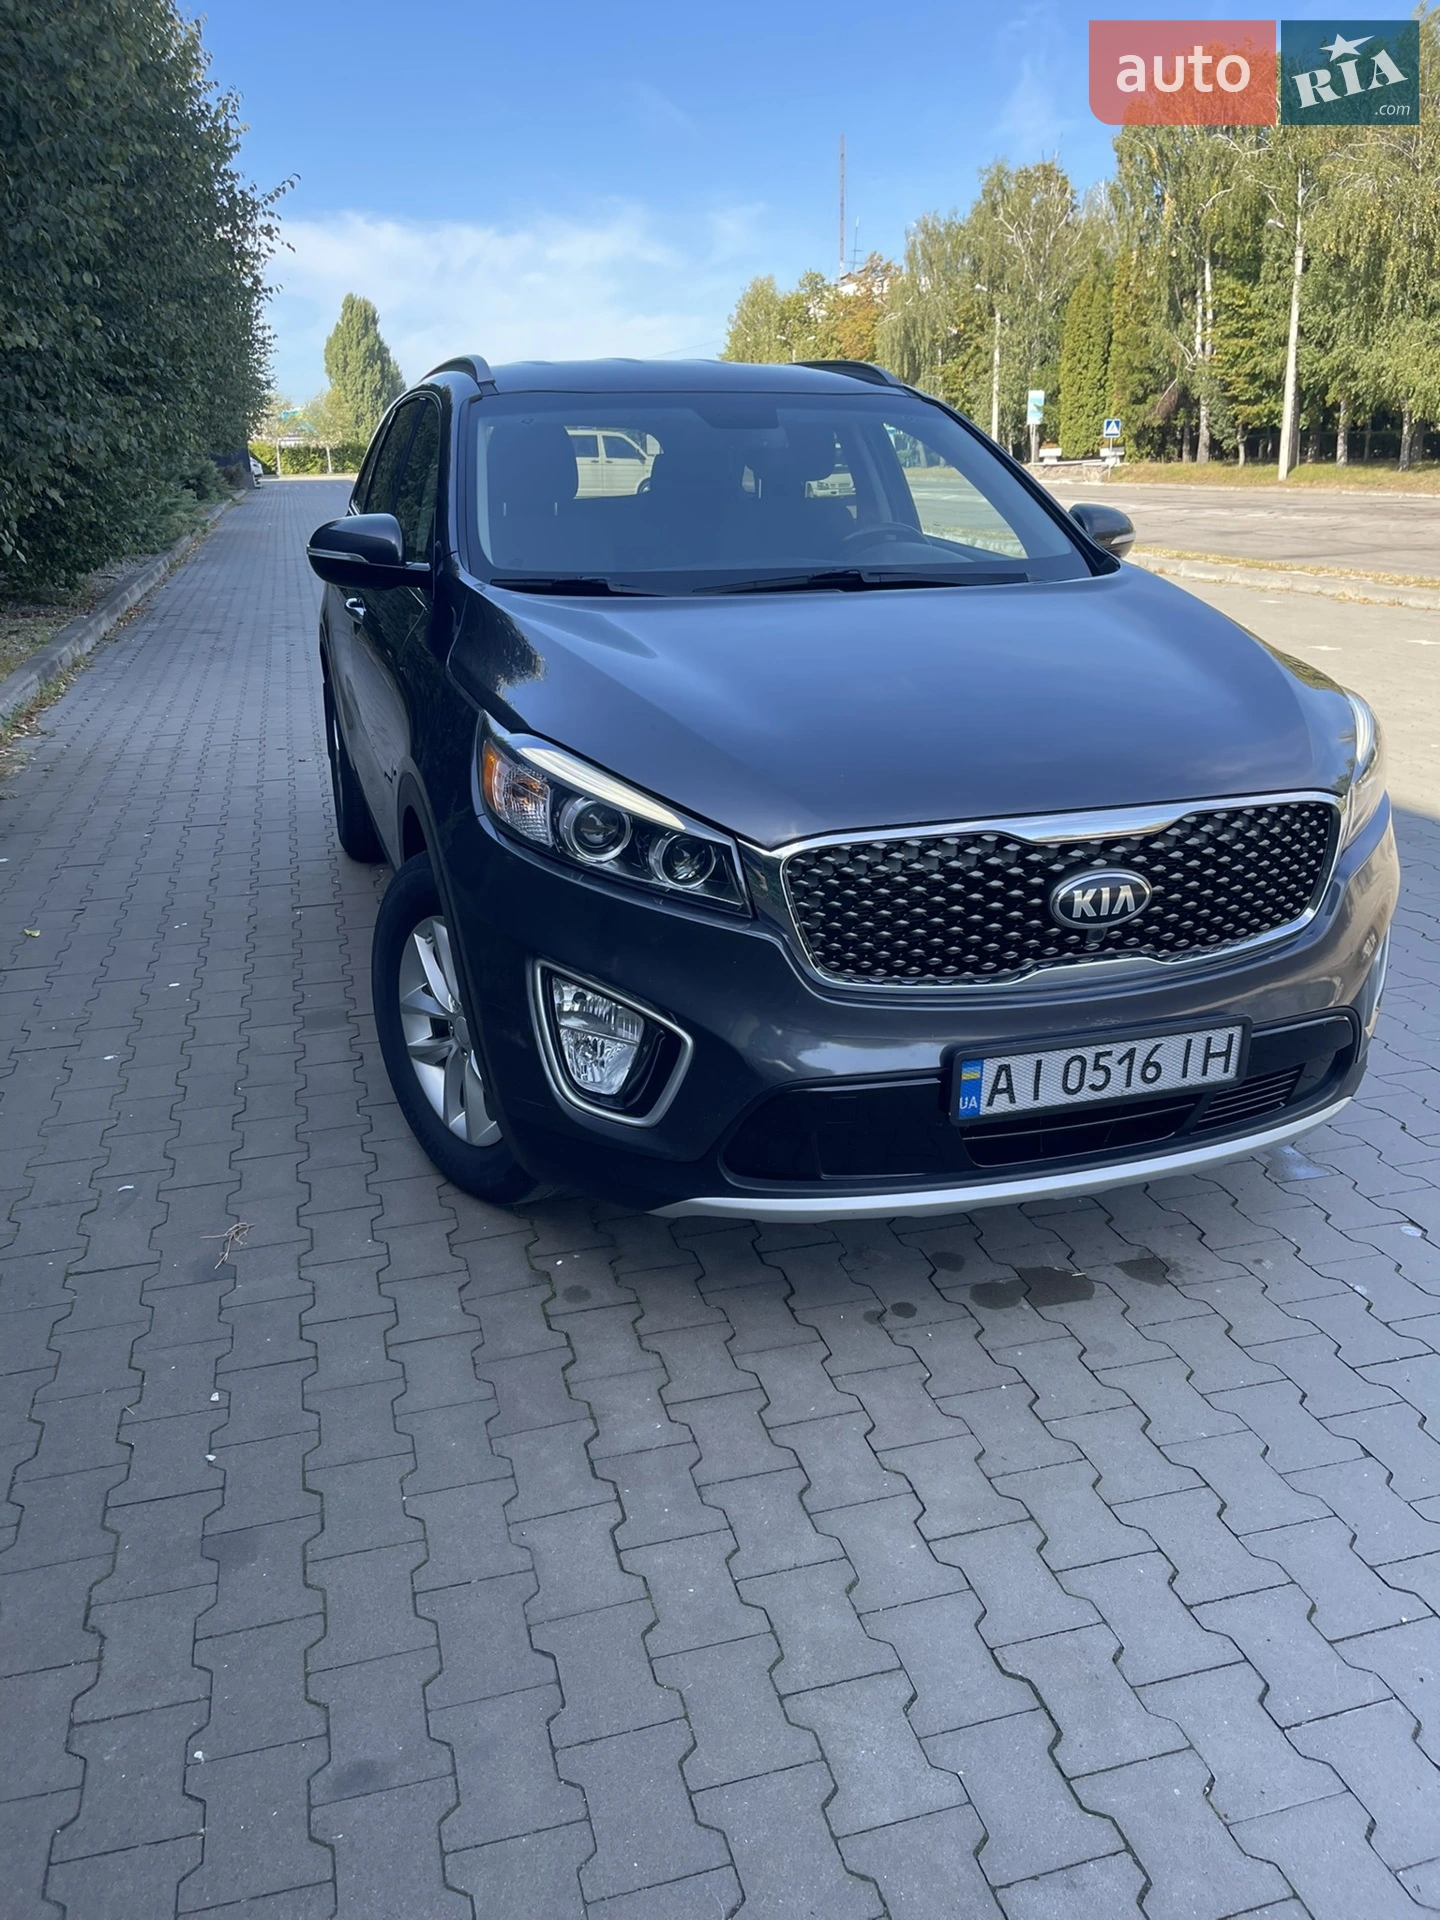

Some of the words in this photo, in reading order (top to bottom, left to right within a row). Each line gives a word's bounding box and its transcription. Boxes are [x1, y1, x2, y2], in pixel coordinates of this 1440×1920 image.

[1072, 884, 1136, 918] KIA
[985, 1059, 1043, 1108] AI
[1061, 1042, 1165, 1096] 0516
[1180, 1032, 1235, 1079] IH
[959, 1096, 979, 1110] UA
